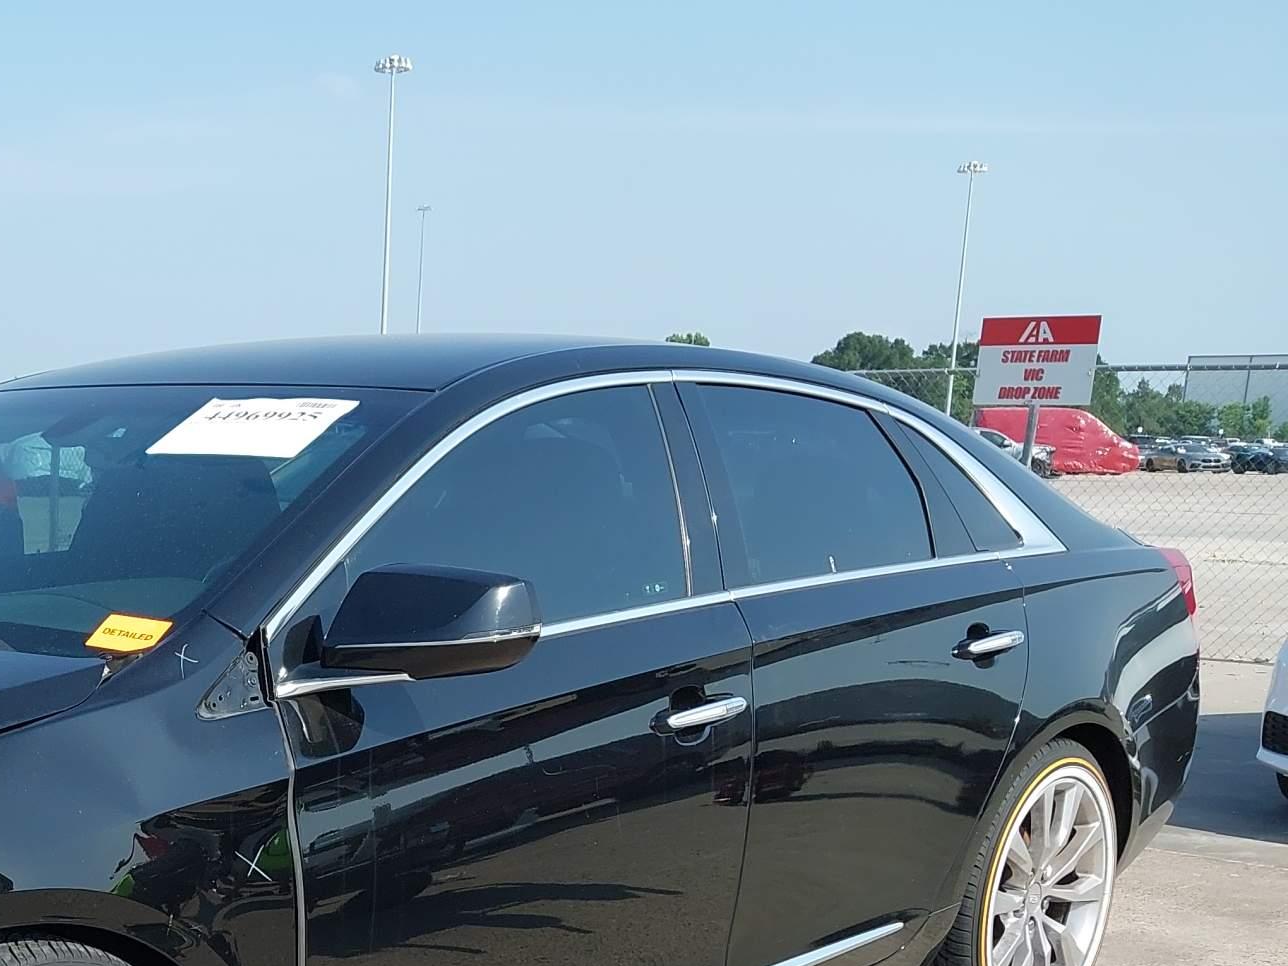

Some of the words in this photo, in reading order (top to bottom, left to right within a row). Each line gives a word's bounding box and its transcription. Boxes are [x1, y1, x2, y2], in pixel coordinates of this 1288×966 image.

[1001, 350, 1036, 363] STATE
[1036, 349, 1071, 363] FARM
[1023, 368, 1045, 382] VIC
[998, 387, 1031, 400] DROP
[1031, 386, 1062, 400] ZONE
[102, 627, 154, 641] DETAILED
